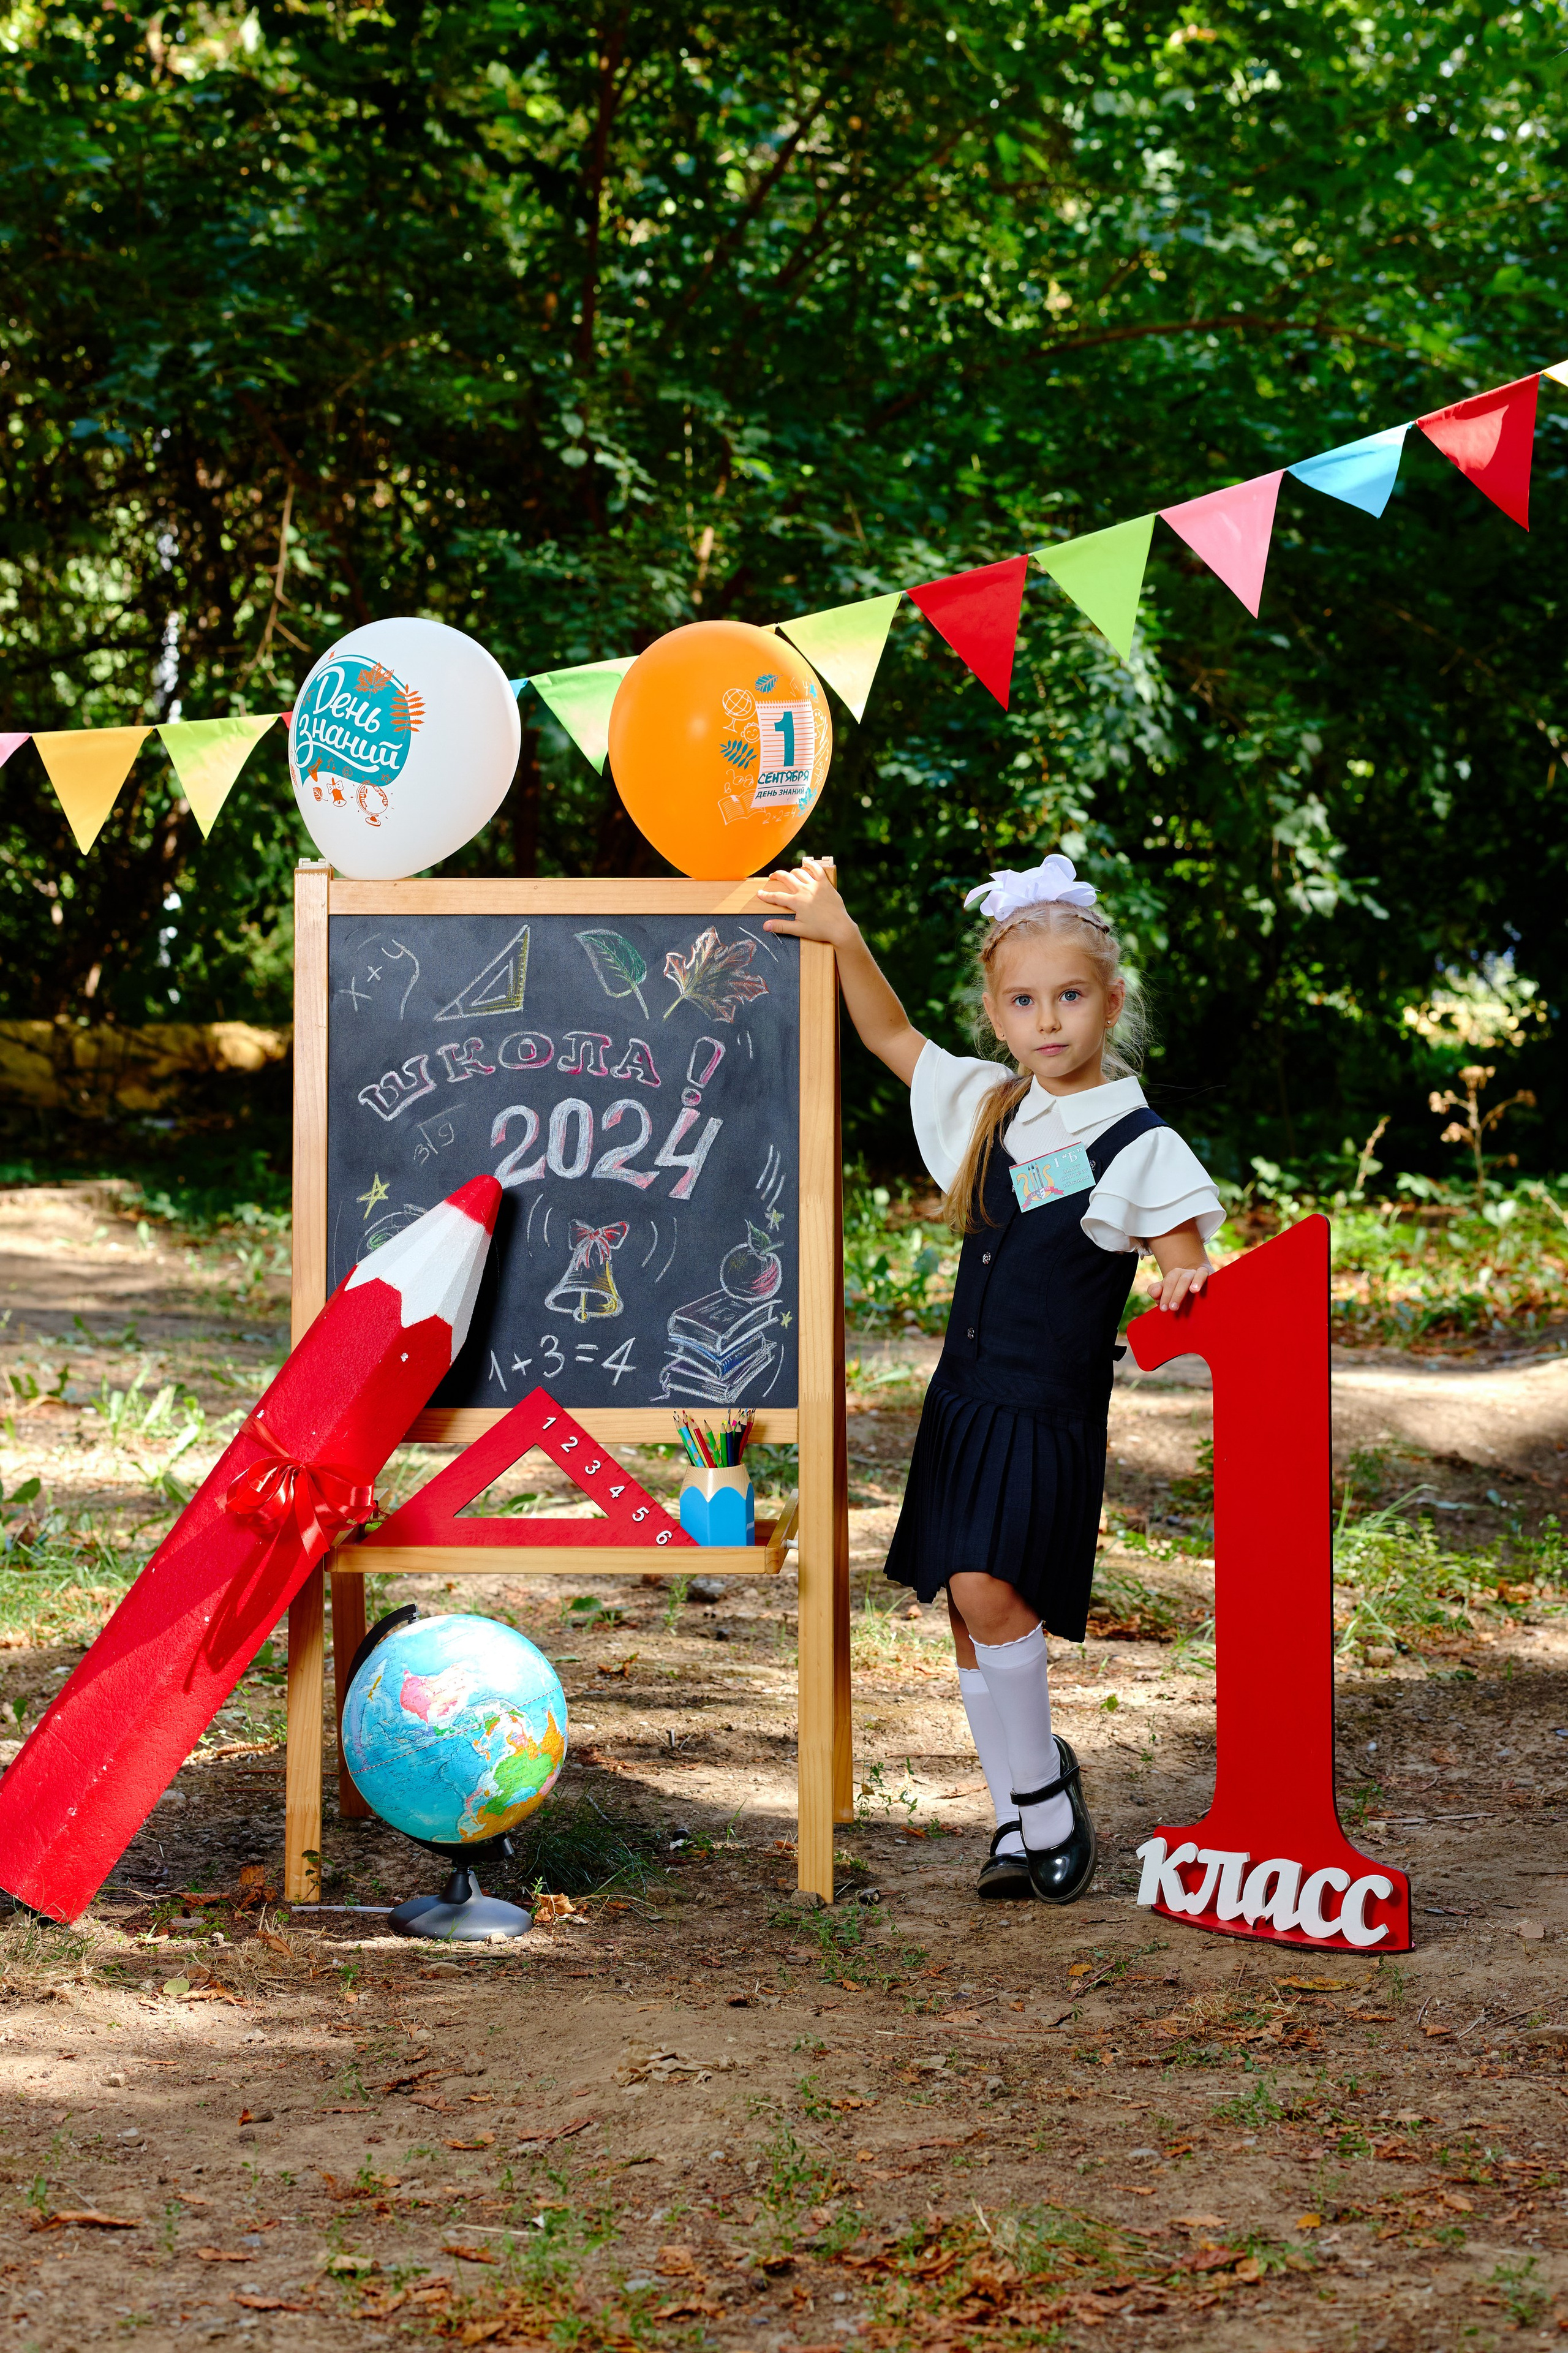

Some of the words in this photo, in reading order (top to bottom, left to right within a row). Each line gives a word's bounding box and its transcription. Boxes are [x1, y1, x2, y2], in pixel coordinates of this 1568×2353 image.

[313, 665, 382, 733] День
[774, 711, 794, 767] 1
[755, 788, 778, 799] ДЕНЬ
[778, 787, 805, 796] ЗНАНИЙ
[758, 769, 809, 785] СЕНТЯБРЯ
[489, 1097, 723, 1200] 2024
[541, 1416, 556, 1430] 1
[560, 1435, 578, 1453] 2
[585, 1459, 601, 1475] 3
[609, 1484, 625, 1498] 4
[631, 1506, 649, 1522] 5
[655, 1530, 673, 1546] 6
